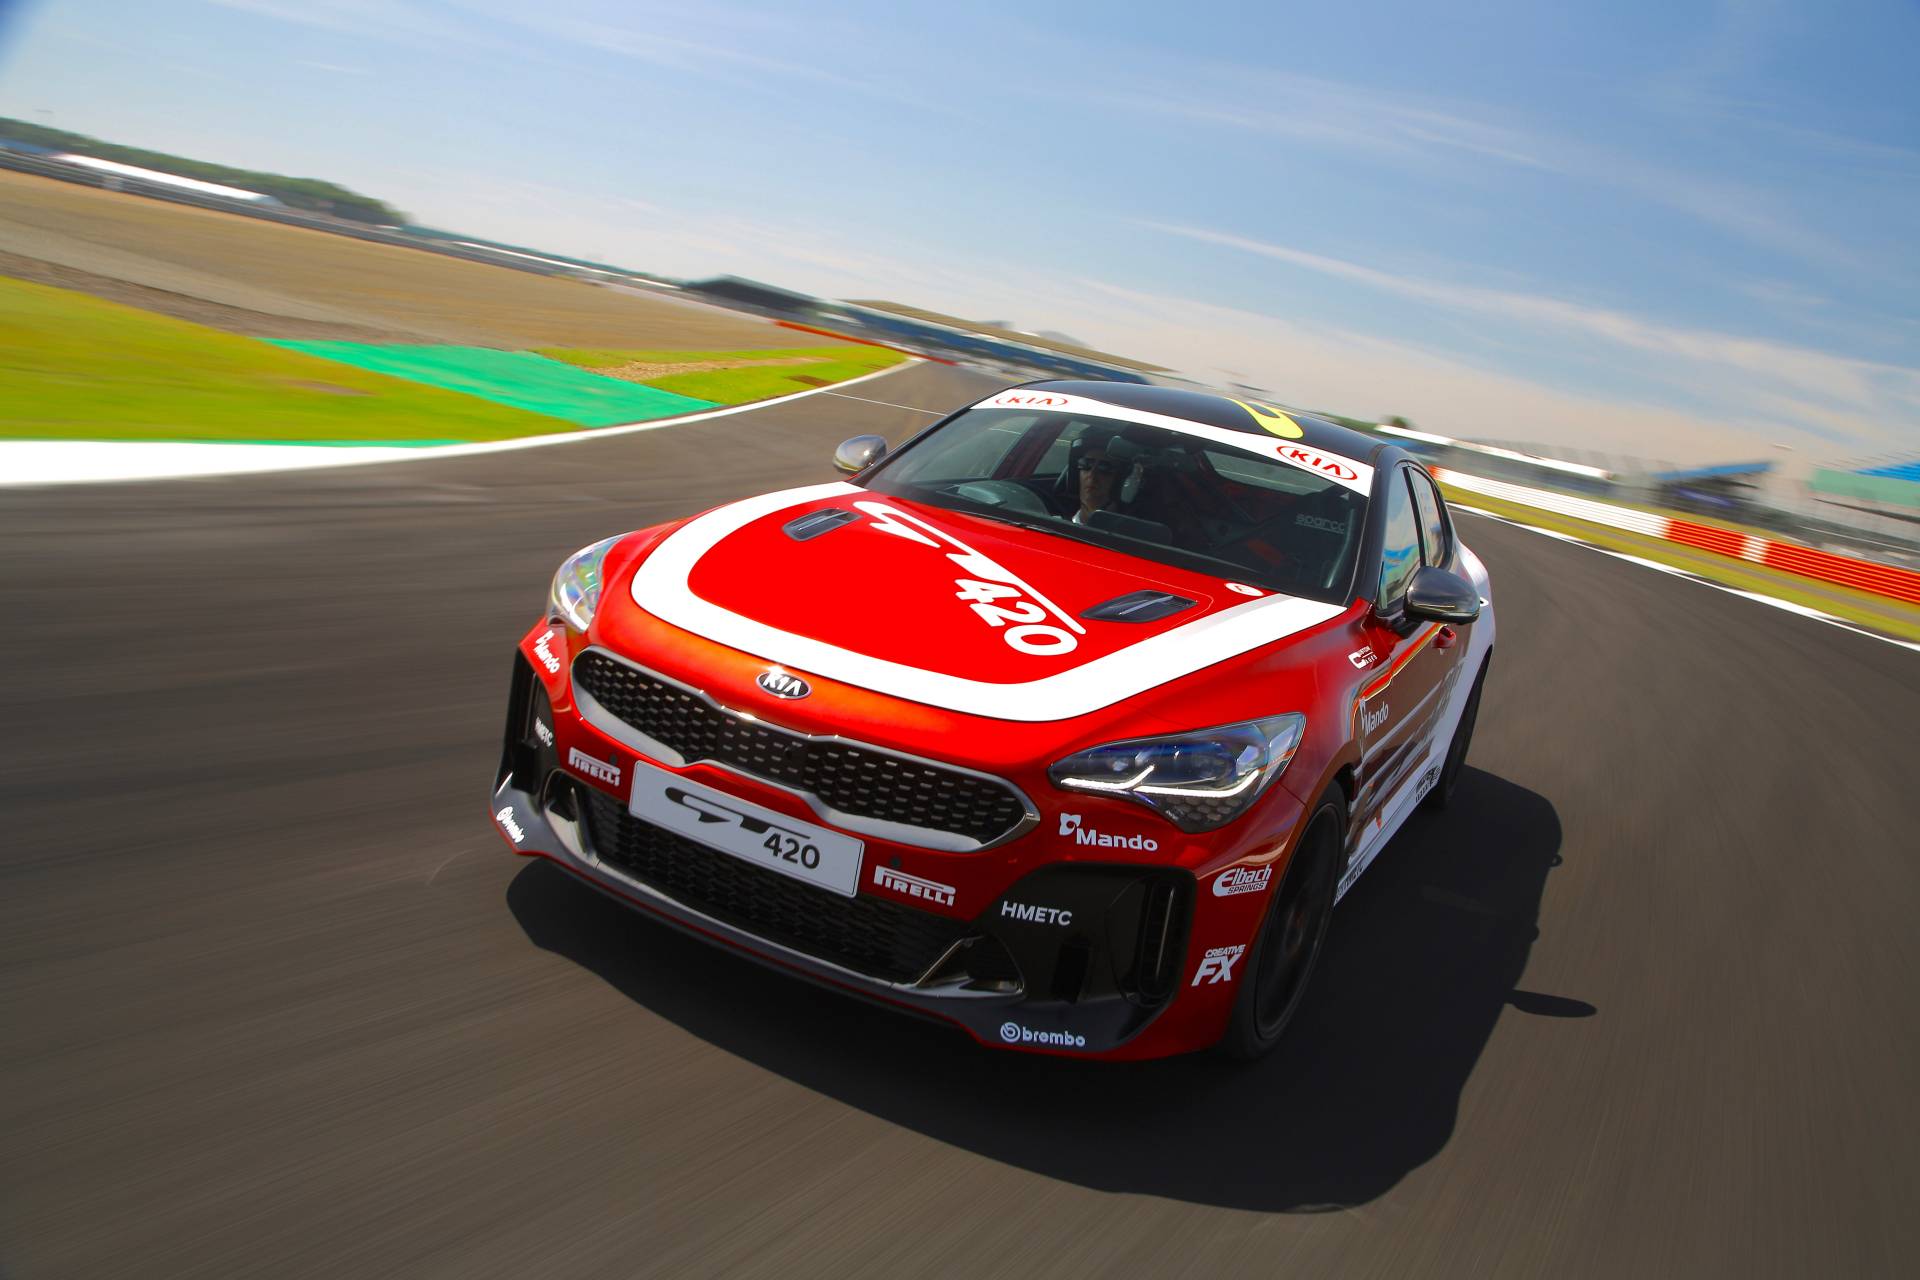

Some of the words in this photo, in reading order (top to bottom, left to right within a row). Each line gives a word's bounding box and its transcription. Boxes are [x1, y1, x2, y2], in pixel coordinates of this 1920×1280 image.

[1007, 397, 1053, 405] KIA
[1290, 449, 1341, 476] KIA
[954, 578, 1078, 656] 420
[763, 672, 801, 696] KIA
[1365, 701, 1389, 738] Mando
[568, 747, 621, 787] PIRELLI
[763, 832, 821, 870] 420
[1075, 828, 1158, 852] Mando
[873, 865, 956, 906] PIRELLI
[1227, 881, 1265, 894] SPRINGS
[1001, 900, 1073, 926] HMETC
[1205, 944, 1246, 958] CREATIVE
[1191, 953, 1242, 987] FX
[1022, 1026, 1086, 1047] brembo
